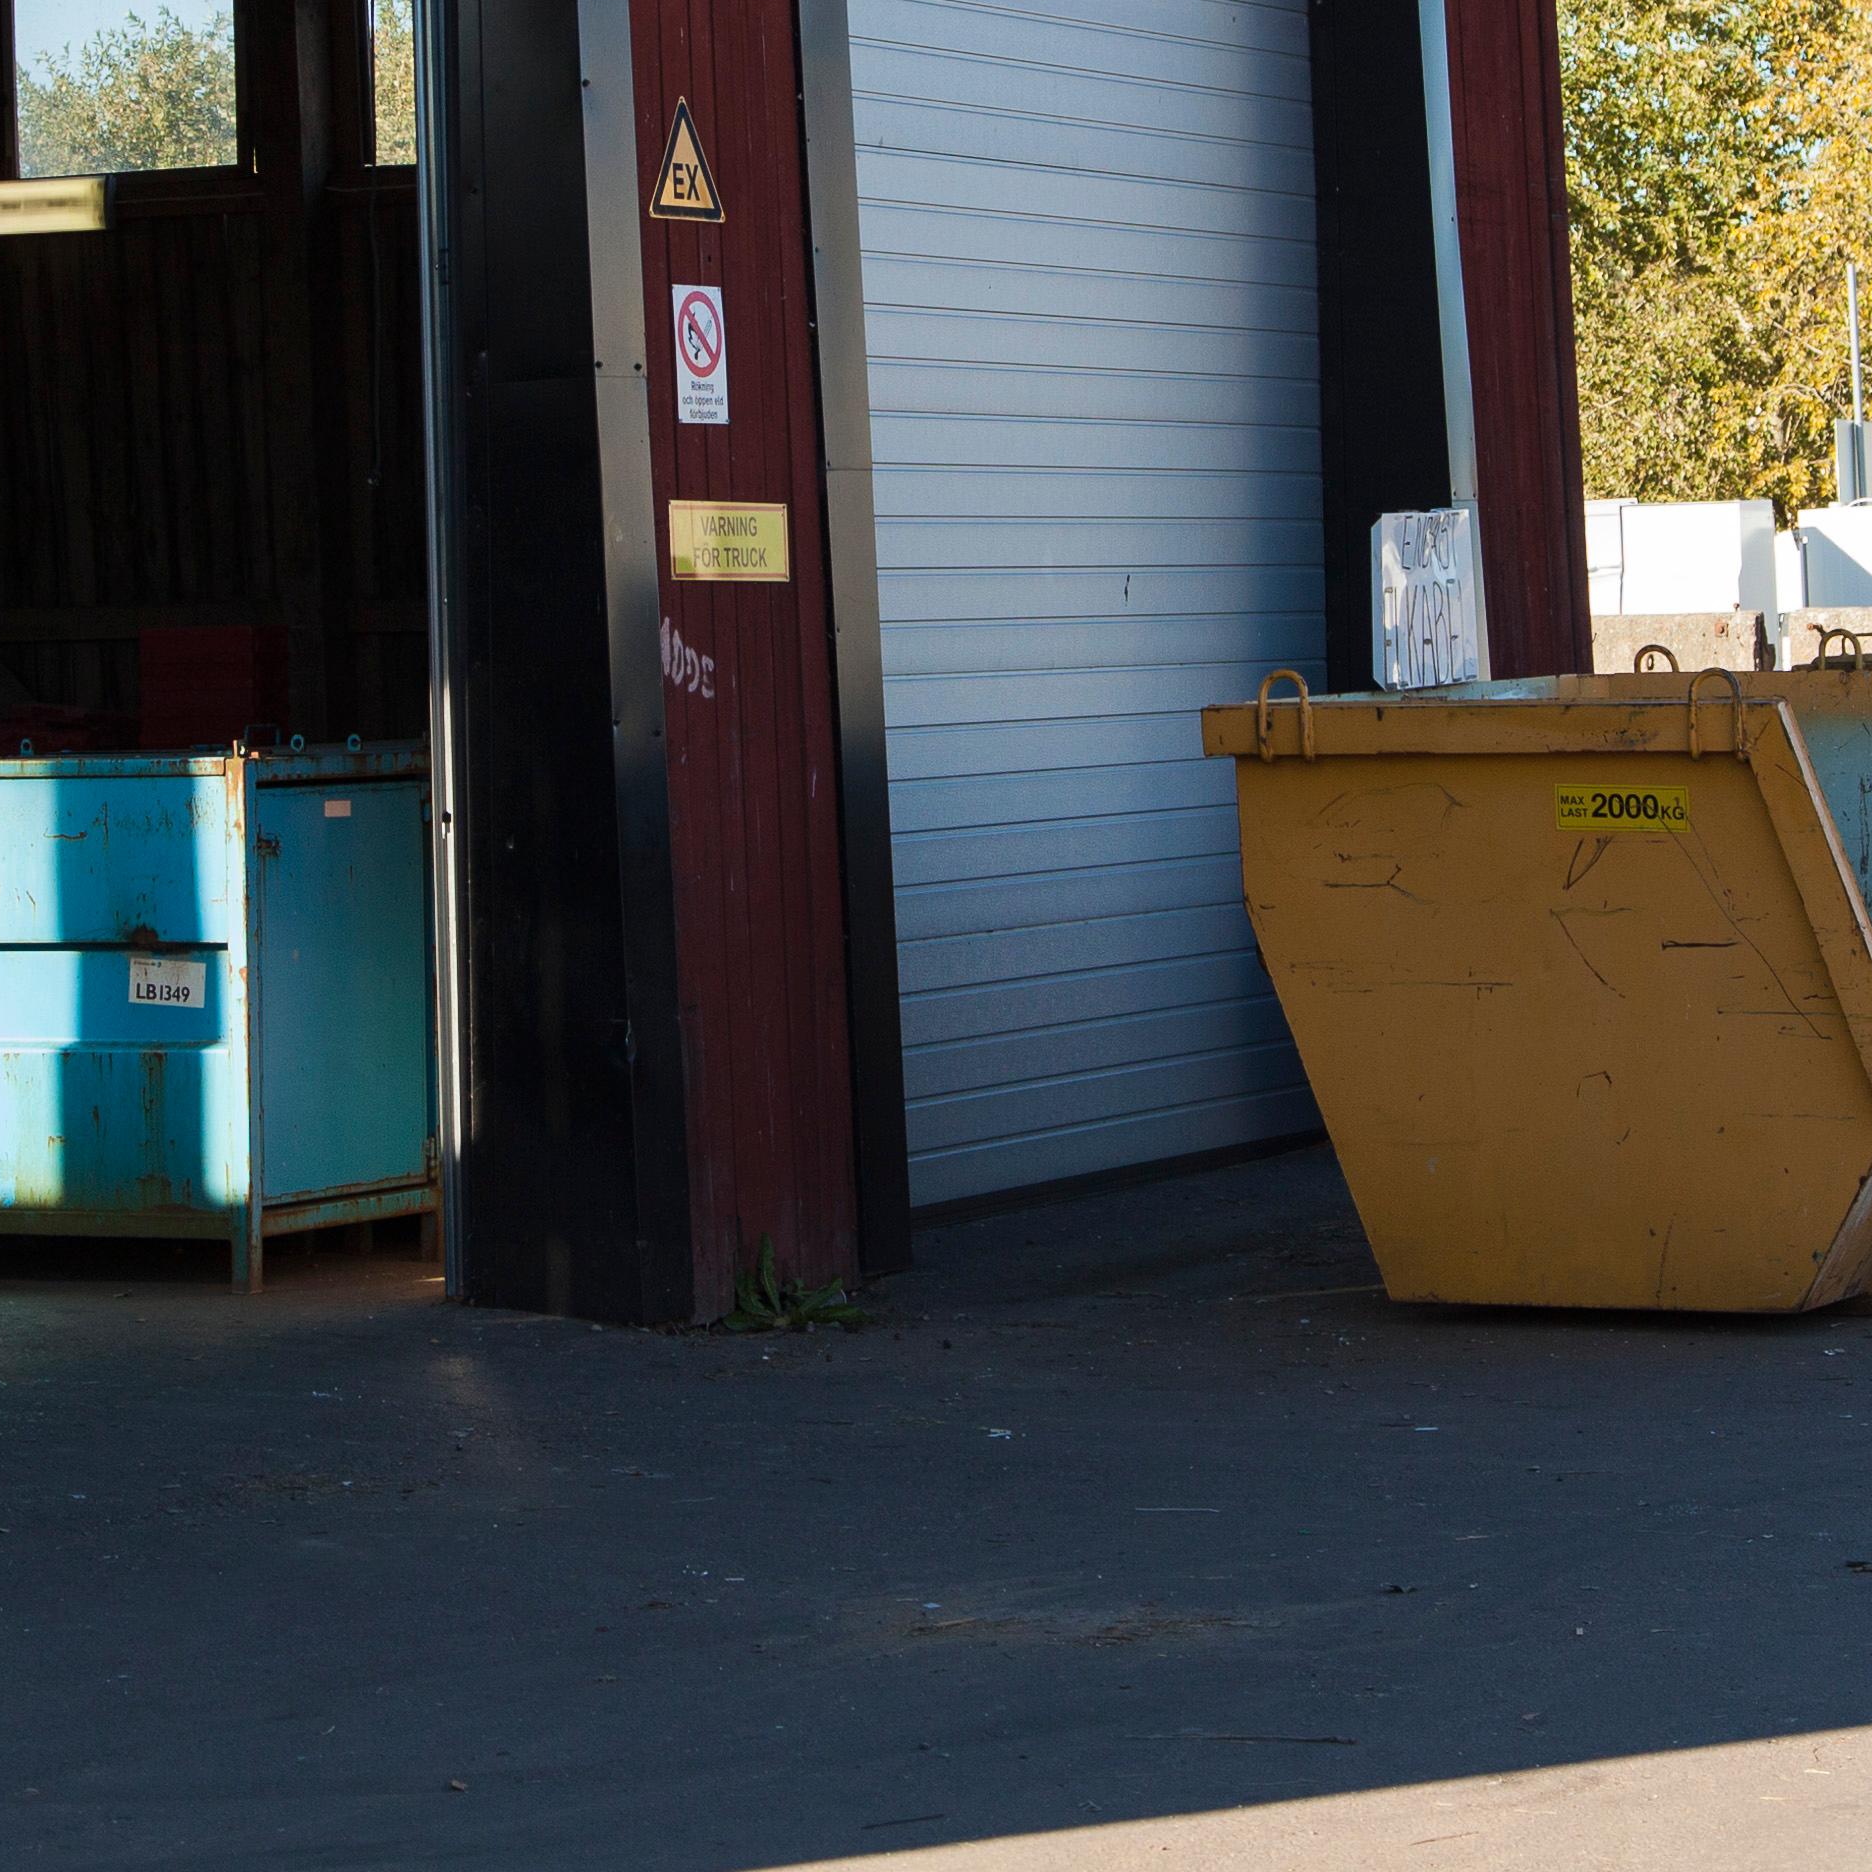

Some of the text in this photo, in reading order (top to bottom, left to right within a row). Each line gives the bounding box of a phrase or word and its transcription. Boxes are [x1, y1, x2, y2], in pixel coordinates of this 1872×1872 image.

[672, 162, 701, 201] EX
[690, 380, 715, 393] Rökning
[682, 395, 724, 406] och öppen eld
[701, 516, 758, 536] VARNING
[693, 543, 768, 568] FÖR TRUCK
[1560, 795, 1585, 805] MAX
[1591, 793, 1685, 820] 2000 KG
[1560, 808, 1588, 817] LAST
